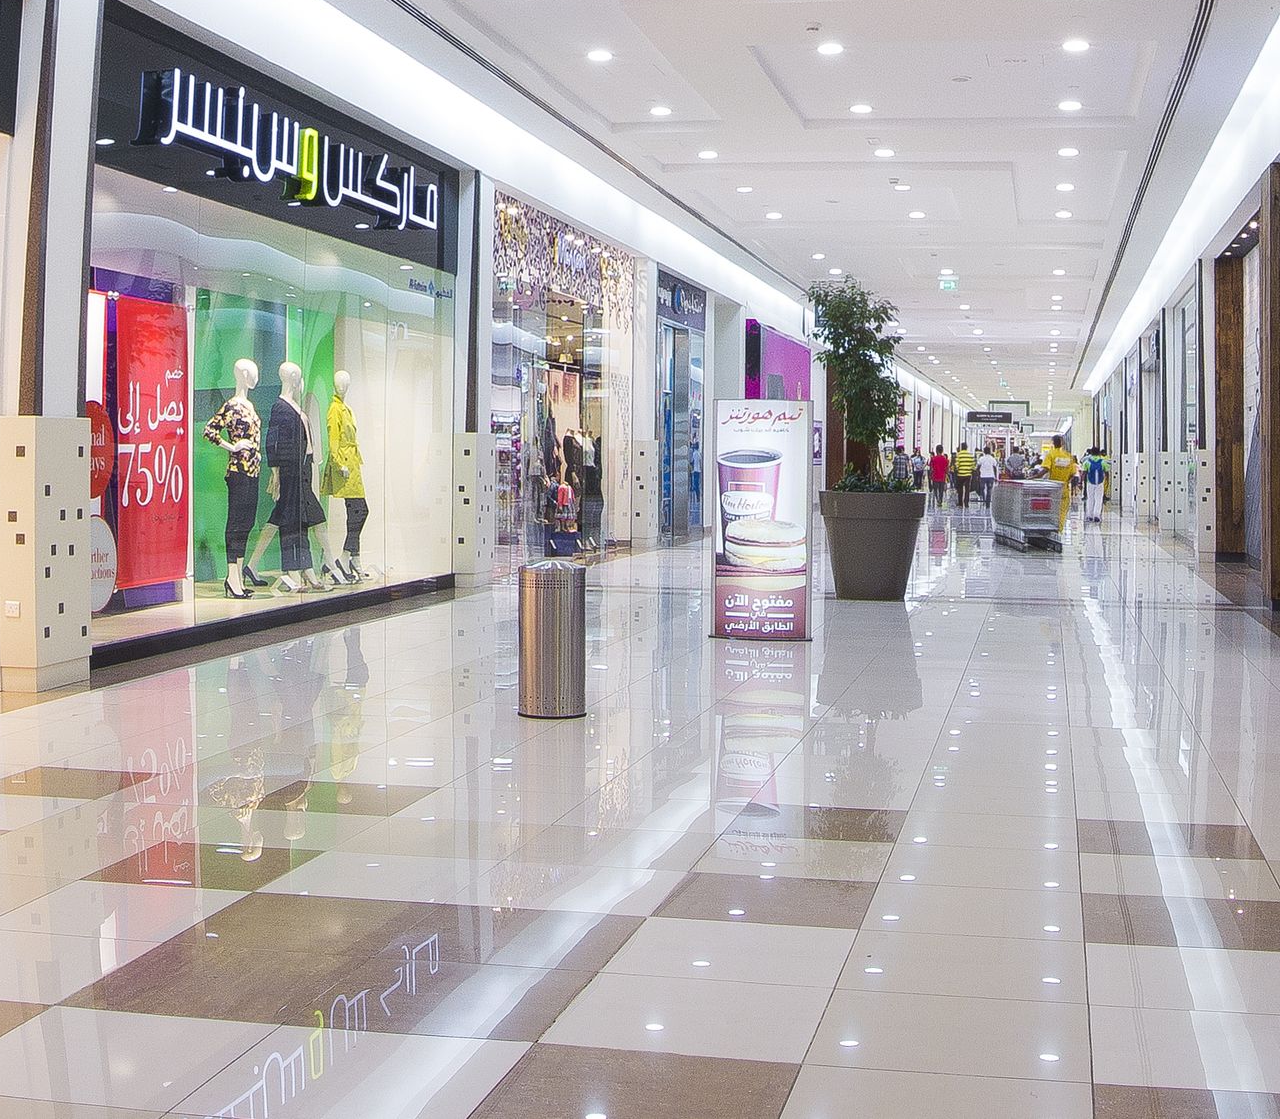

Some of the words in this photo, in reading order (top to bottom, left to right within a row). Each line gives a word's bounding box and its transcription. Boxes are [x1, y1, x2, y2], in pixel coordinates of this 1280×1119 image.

[323, 136, 438, 230] ماركس
[165, 365, 184, 388] خصم
[118, 380, 141, 435] إلى
[148, 383, 185, 436] يصل
[91, 424, 106, 447] nal
[90, 459, 106, 479] ays
[118, 442, 184, 508] 75%
[91, 547, 109, 564] rther
[725, 593, 749, 608] الآن
[752, 595, 794, 611] مفتوح
[750, 610, 767, 620] في
[725, 620, 760, 633] الأرضي
[761, 621, 794, 634] الطابق
